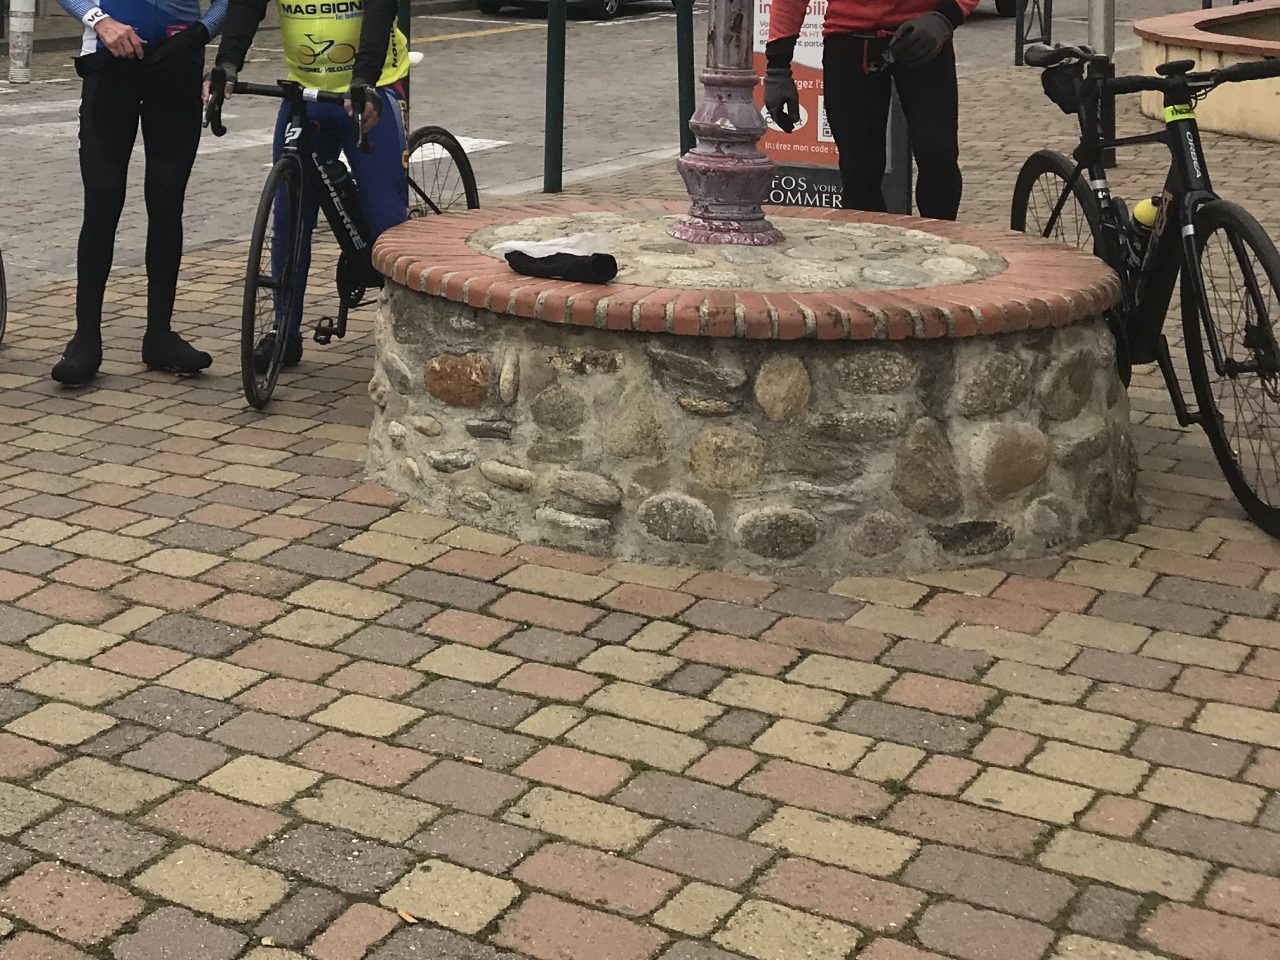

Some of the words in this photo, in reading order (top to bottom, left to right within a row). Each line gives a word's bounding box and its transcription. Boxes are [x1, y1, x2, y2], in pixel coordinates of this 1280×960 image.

[282, 2, 317, 15] MAG
[320, 0, 364, 14] GION
[765, 141, 792, 151] Insérez
[793, 144, 809, 152] mon
[811, 145, 829, 154] code
[1186, 131, 1202, 178] ORBEA
[812, 183, 837, 193] VOIR
[763, 189, 843, 209] OMMER
